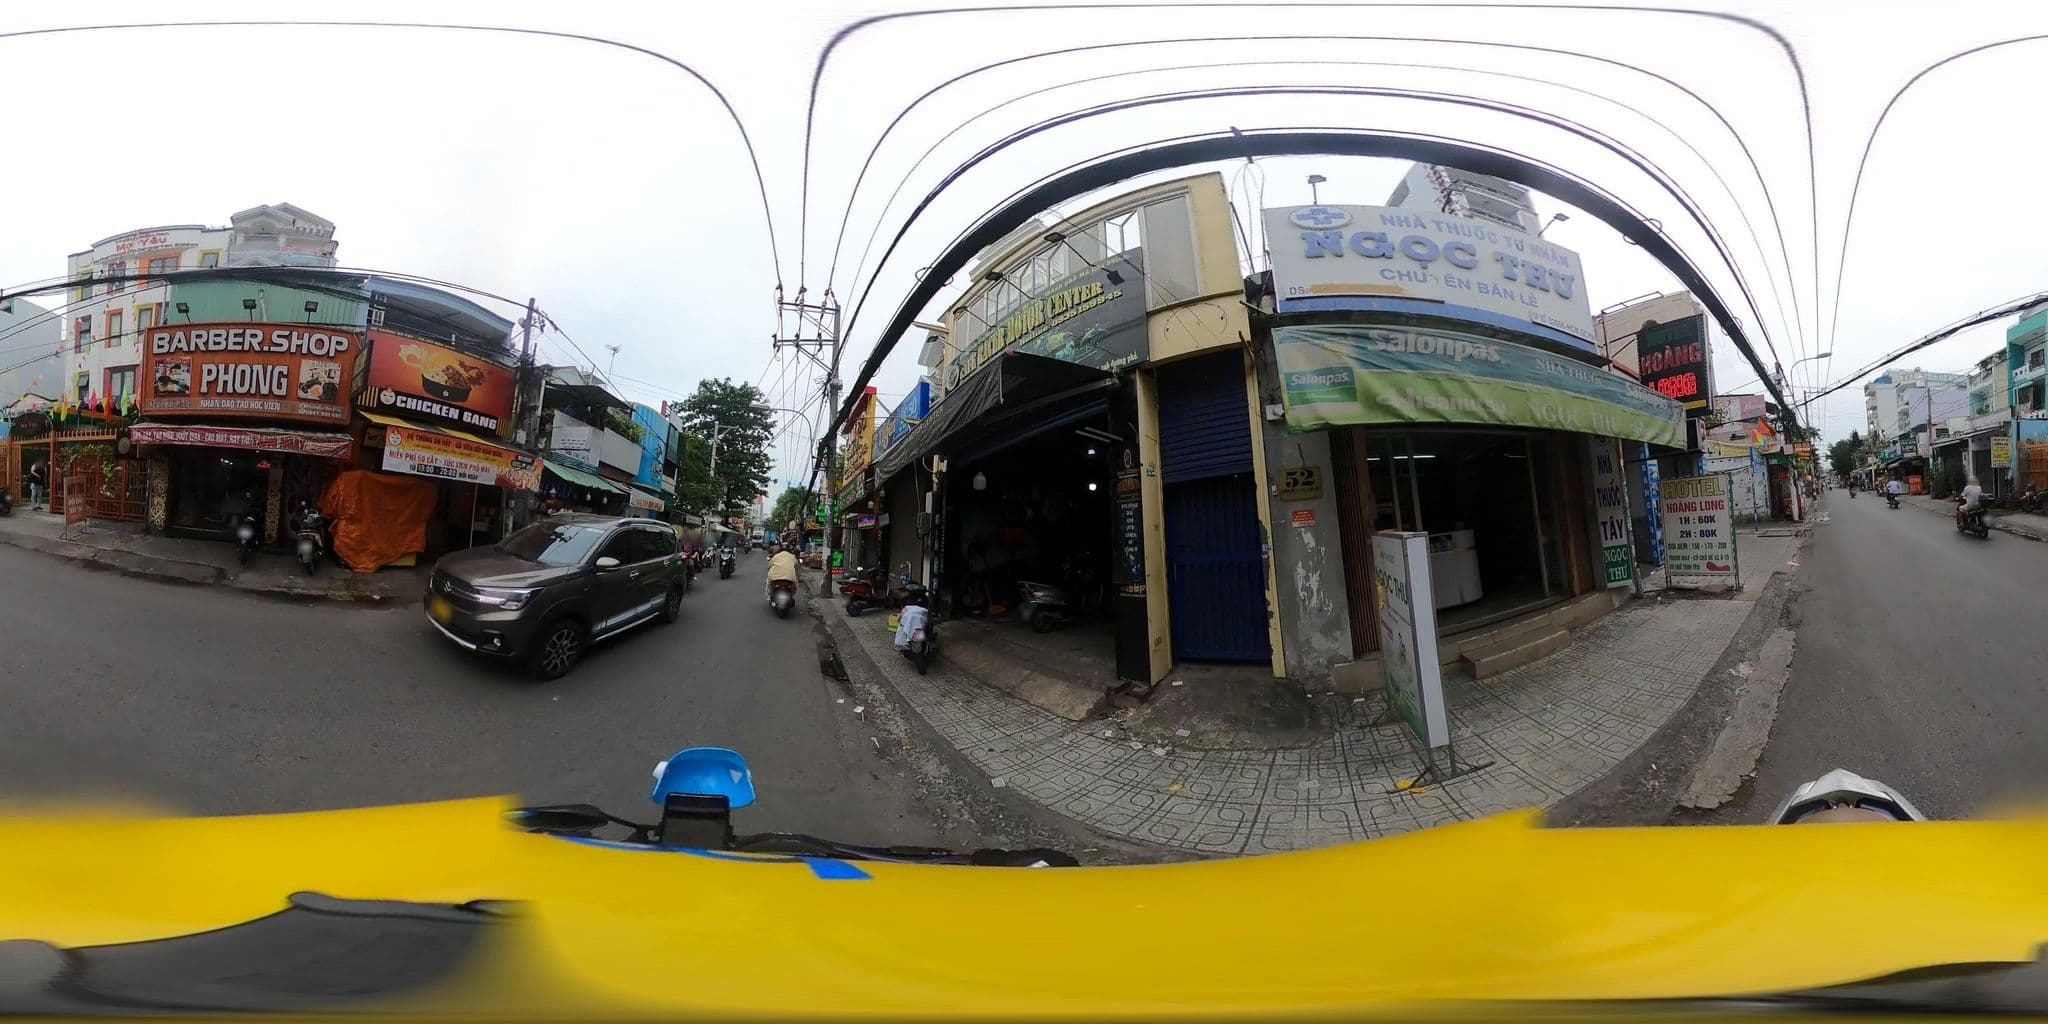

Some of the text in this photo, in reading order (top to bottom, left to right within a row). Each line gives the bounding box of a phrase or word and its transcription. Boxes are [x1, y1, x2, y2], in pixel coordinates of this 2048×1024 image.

[1379, 213, 1427, 230] NHÀ
[1301, 231, 1479, 269] NGỌC
[1477, 282, 1515, 301] BÁN
[1007, 282, 1104, 344] MOTOR CENTER
[152, 328, 349, 358] BARBER.SHOP
[1368, 329, 1501, 363] Salonpas
[1641, 343, 1702, 375] HOÀNG
[200, 362, 289, 397] PHONG
[396, 395, 497, 430] CHICKEN GANG
[404, 452, 417, 463] PHÍ
[1597, 451, 1613, 475] NHÀ
[1286, 470, 1316, 488] 52
[1663, 477, 1725, 499] HOTEL
[1597, 478, 1621, 508] THUỐC
[1666, 500, 1725, 513] HOÀNG LONG
[1601, 515, 1624, 541] TÂY
[1679, 516, 1690, 525] 1H
[1698, 515, 1716, 524] 60K
[1680, 530, 1691, 538] 2H
[1699, 529, 1717, 538] 80K
[1604, 547, 1629, 565] NGỌC
